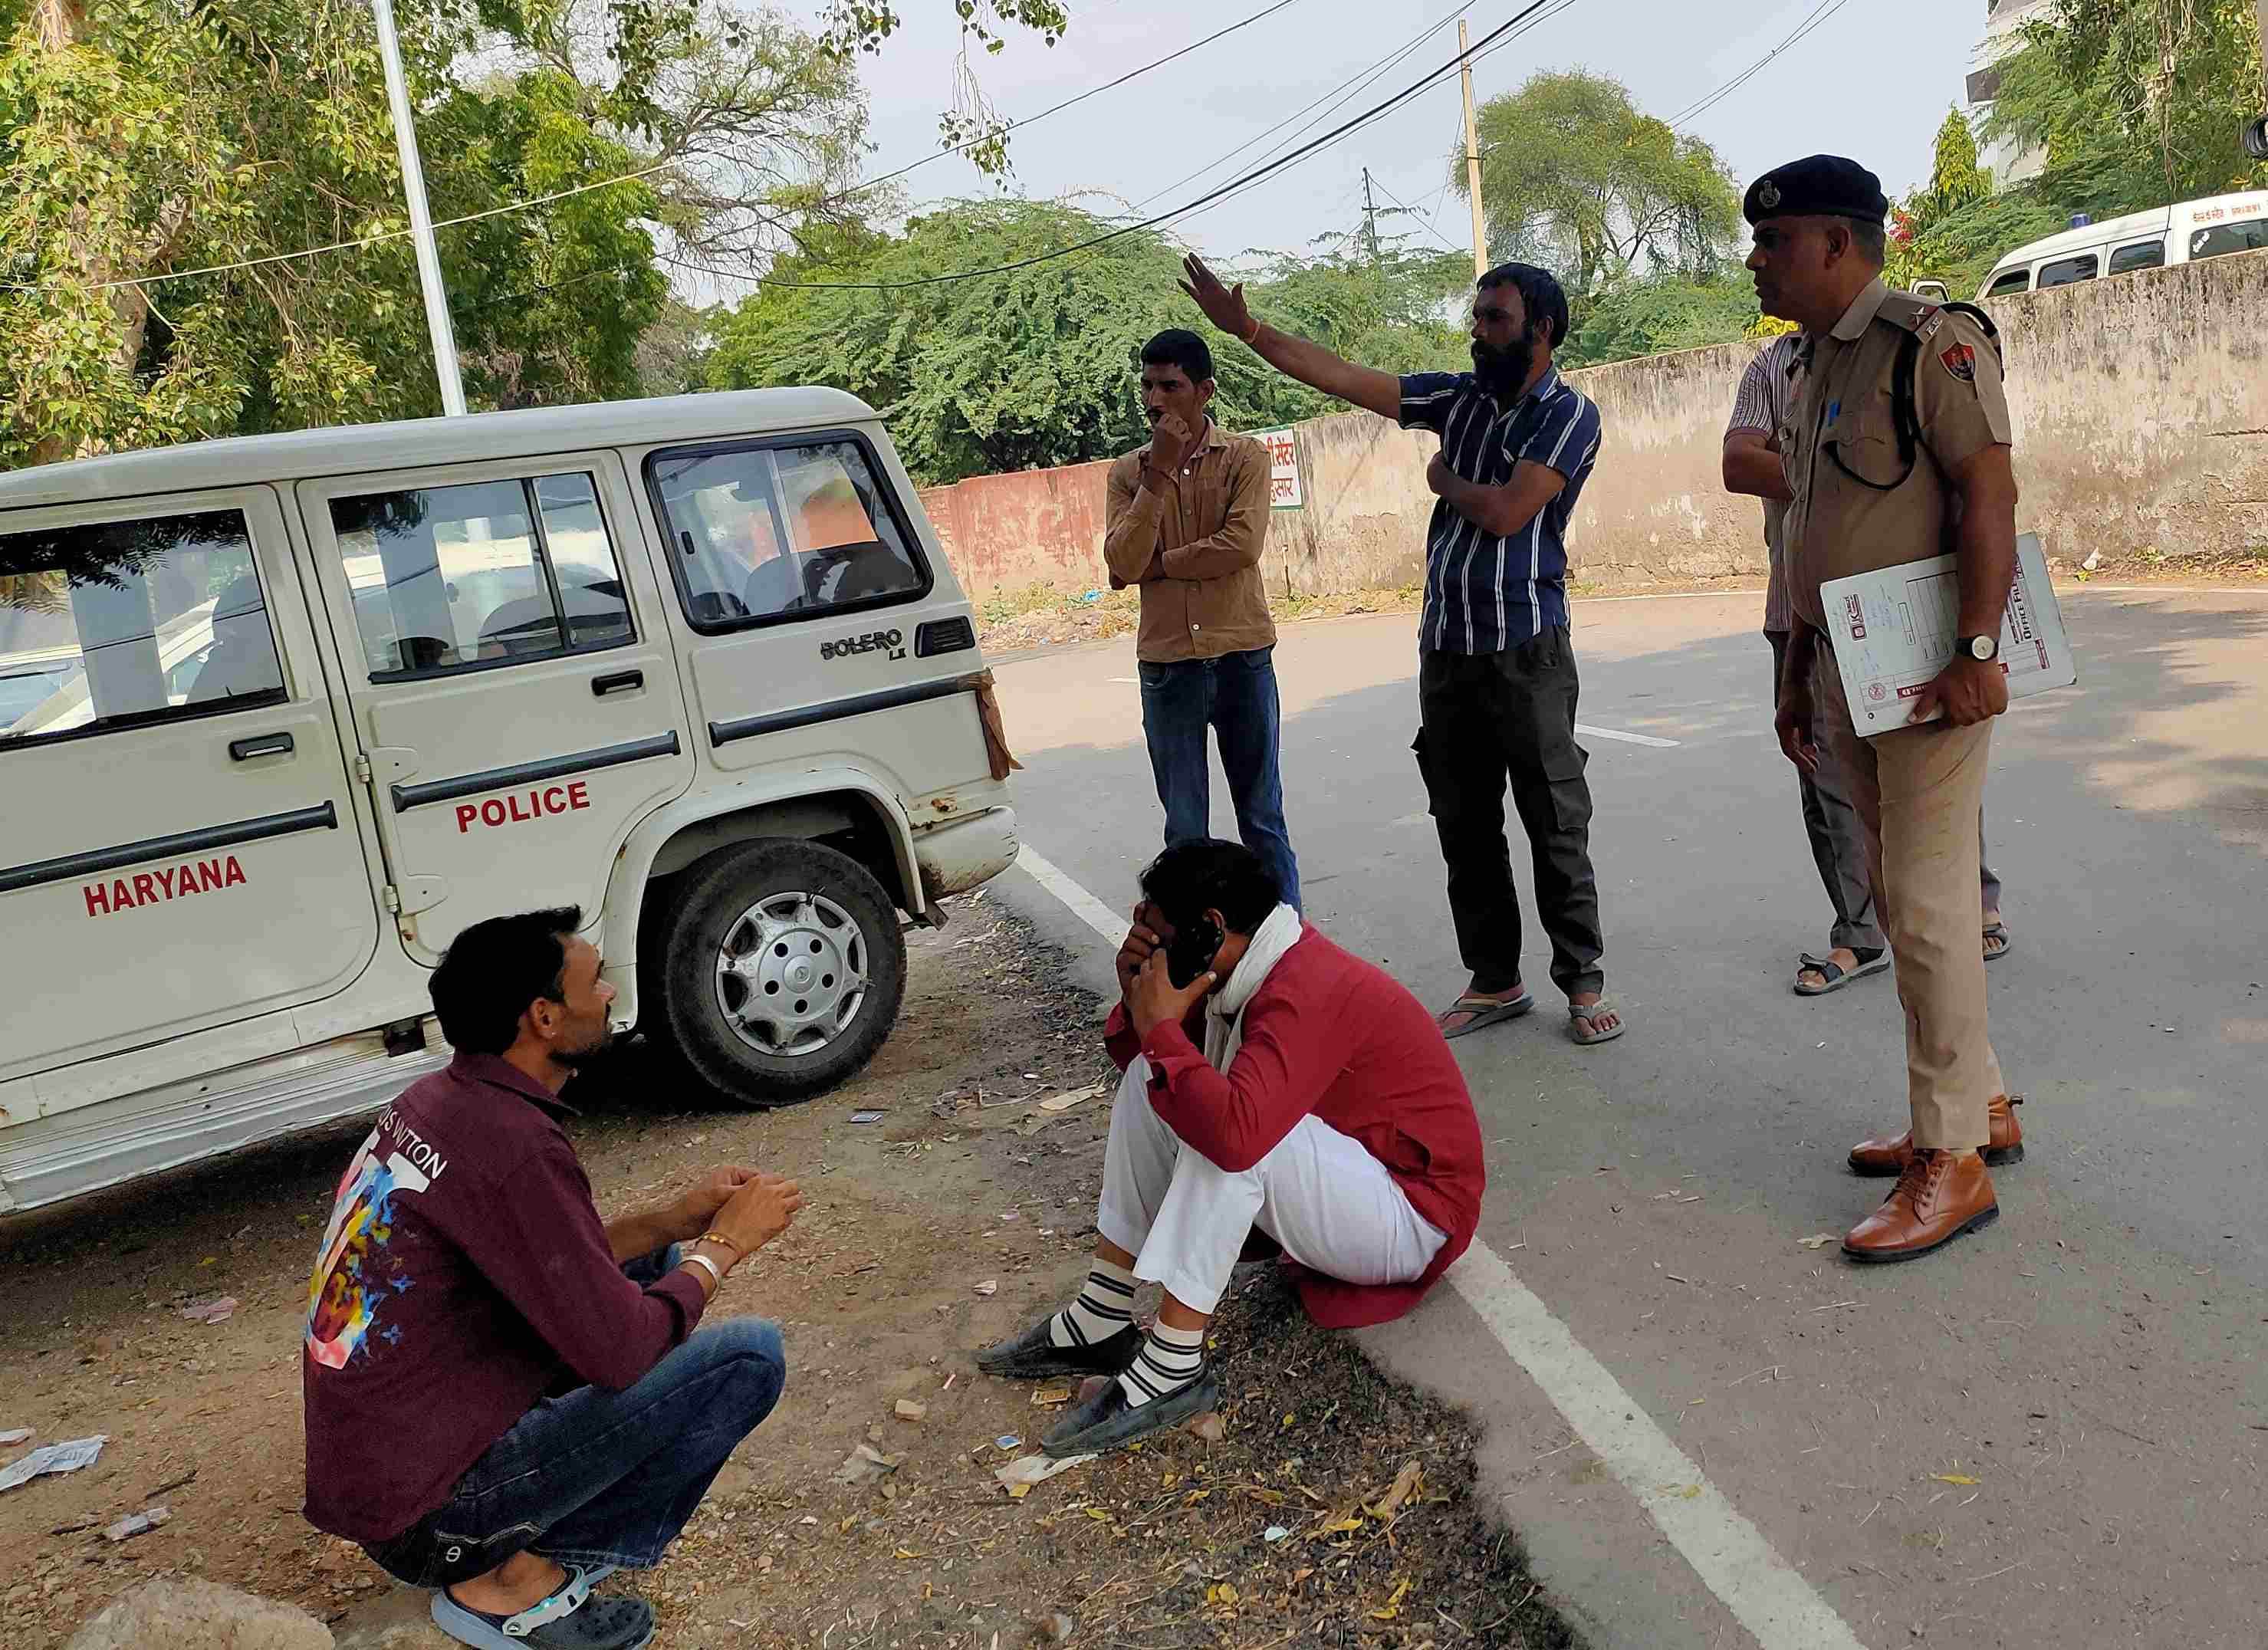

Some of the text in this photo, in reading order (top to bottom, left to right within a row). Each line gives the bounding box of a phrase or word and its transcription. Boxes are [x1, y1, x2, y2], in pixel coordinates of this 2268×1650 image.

[820, 628, 902, 659] BOLERO
[455, 781, 590, 833] POLICE
[84, 856, 247, 918] HARYANA
